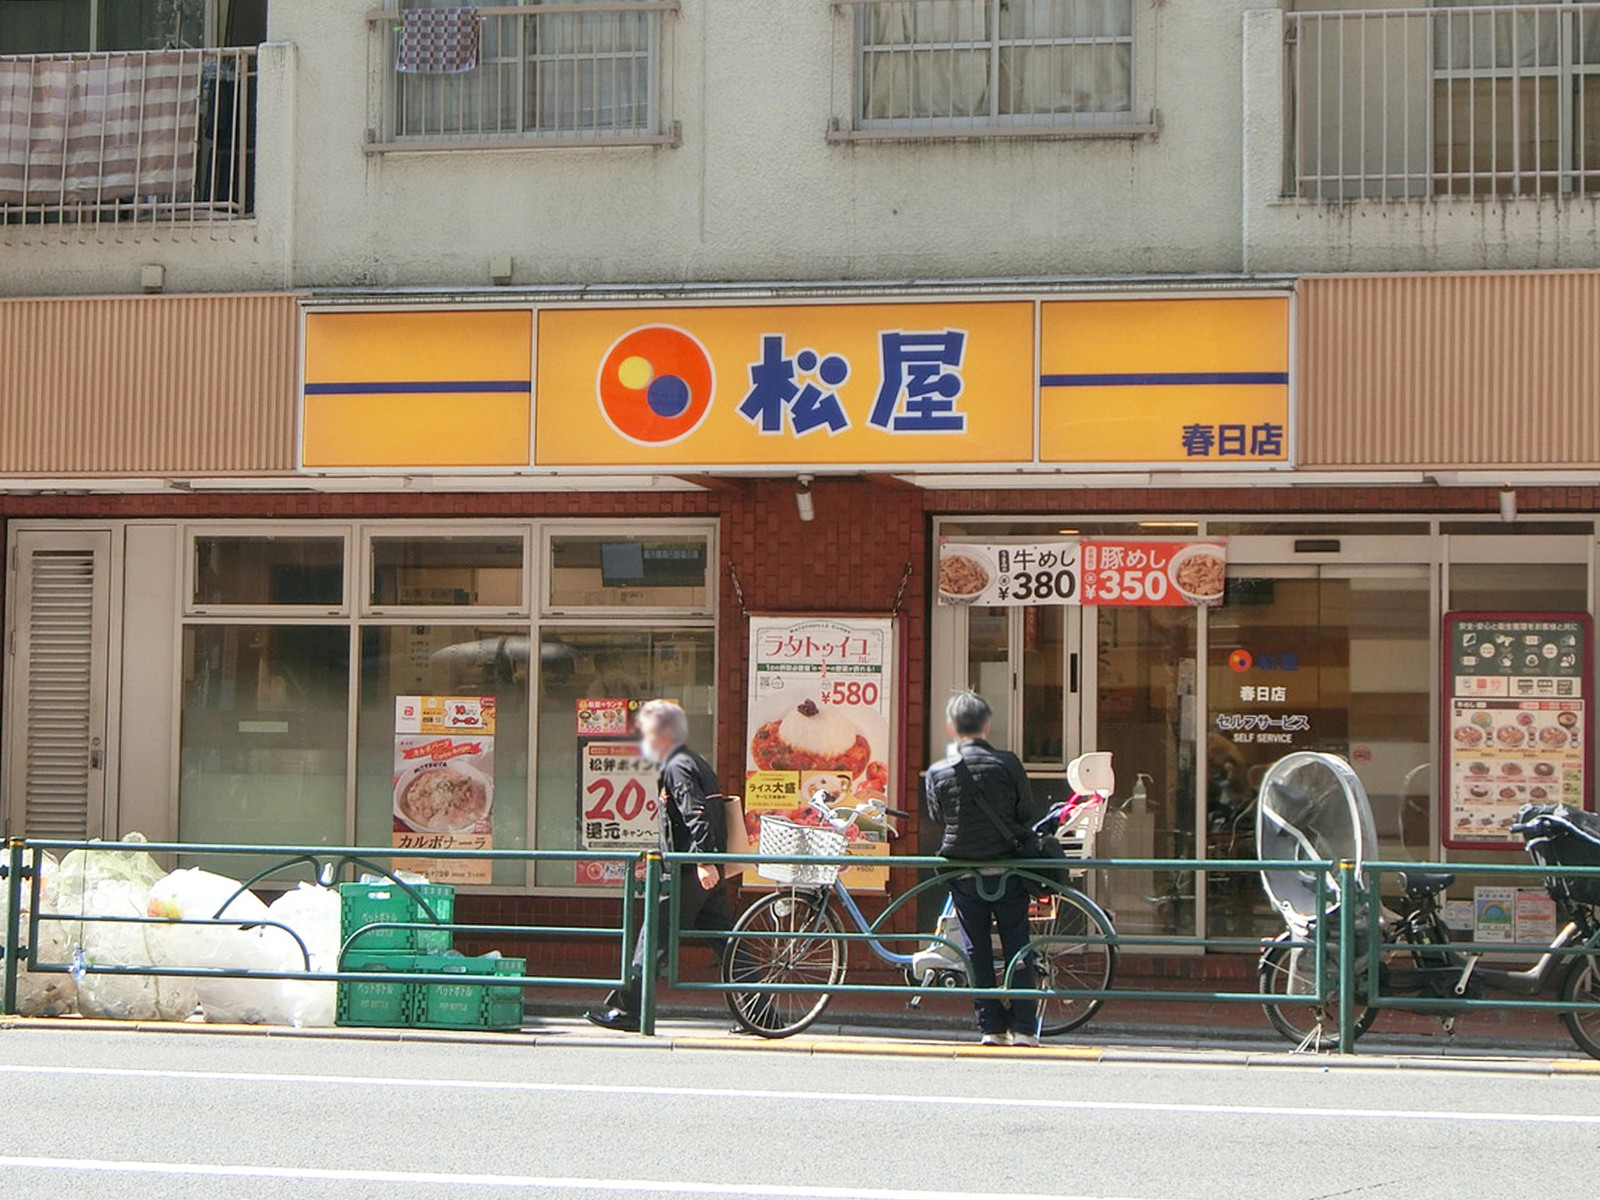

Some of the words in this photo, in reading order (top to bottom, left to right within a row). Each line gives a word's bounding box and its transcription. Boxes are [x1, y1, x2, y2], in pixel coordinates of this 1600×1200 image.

[737, 328, 967, 437] 松屋
[1182, 423, 1283, 456] 春日店
[1013, 549, 1076, 570] 牛めし
[1100, 546, 1166, 569] 豚めし
[1240, 686, 1287, 702] 春日店
[1217, 714, 1310, 731] セルフサービス
[1234, 733, 1254, 743] SELF
[1257, 733, 1293, 743] SERVICE
[749, 782, 796, 794] ライス大盛
[399, 835, 487, 850] カルボナーラ
